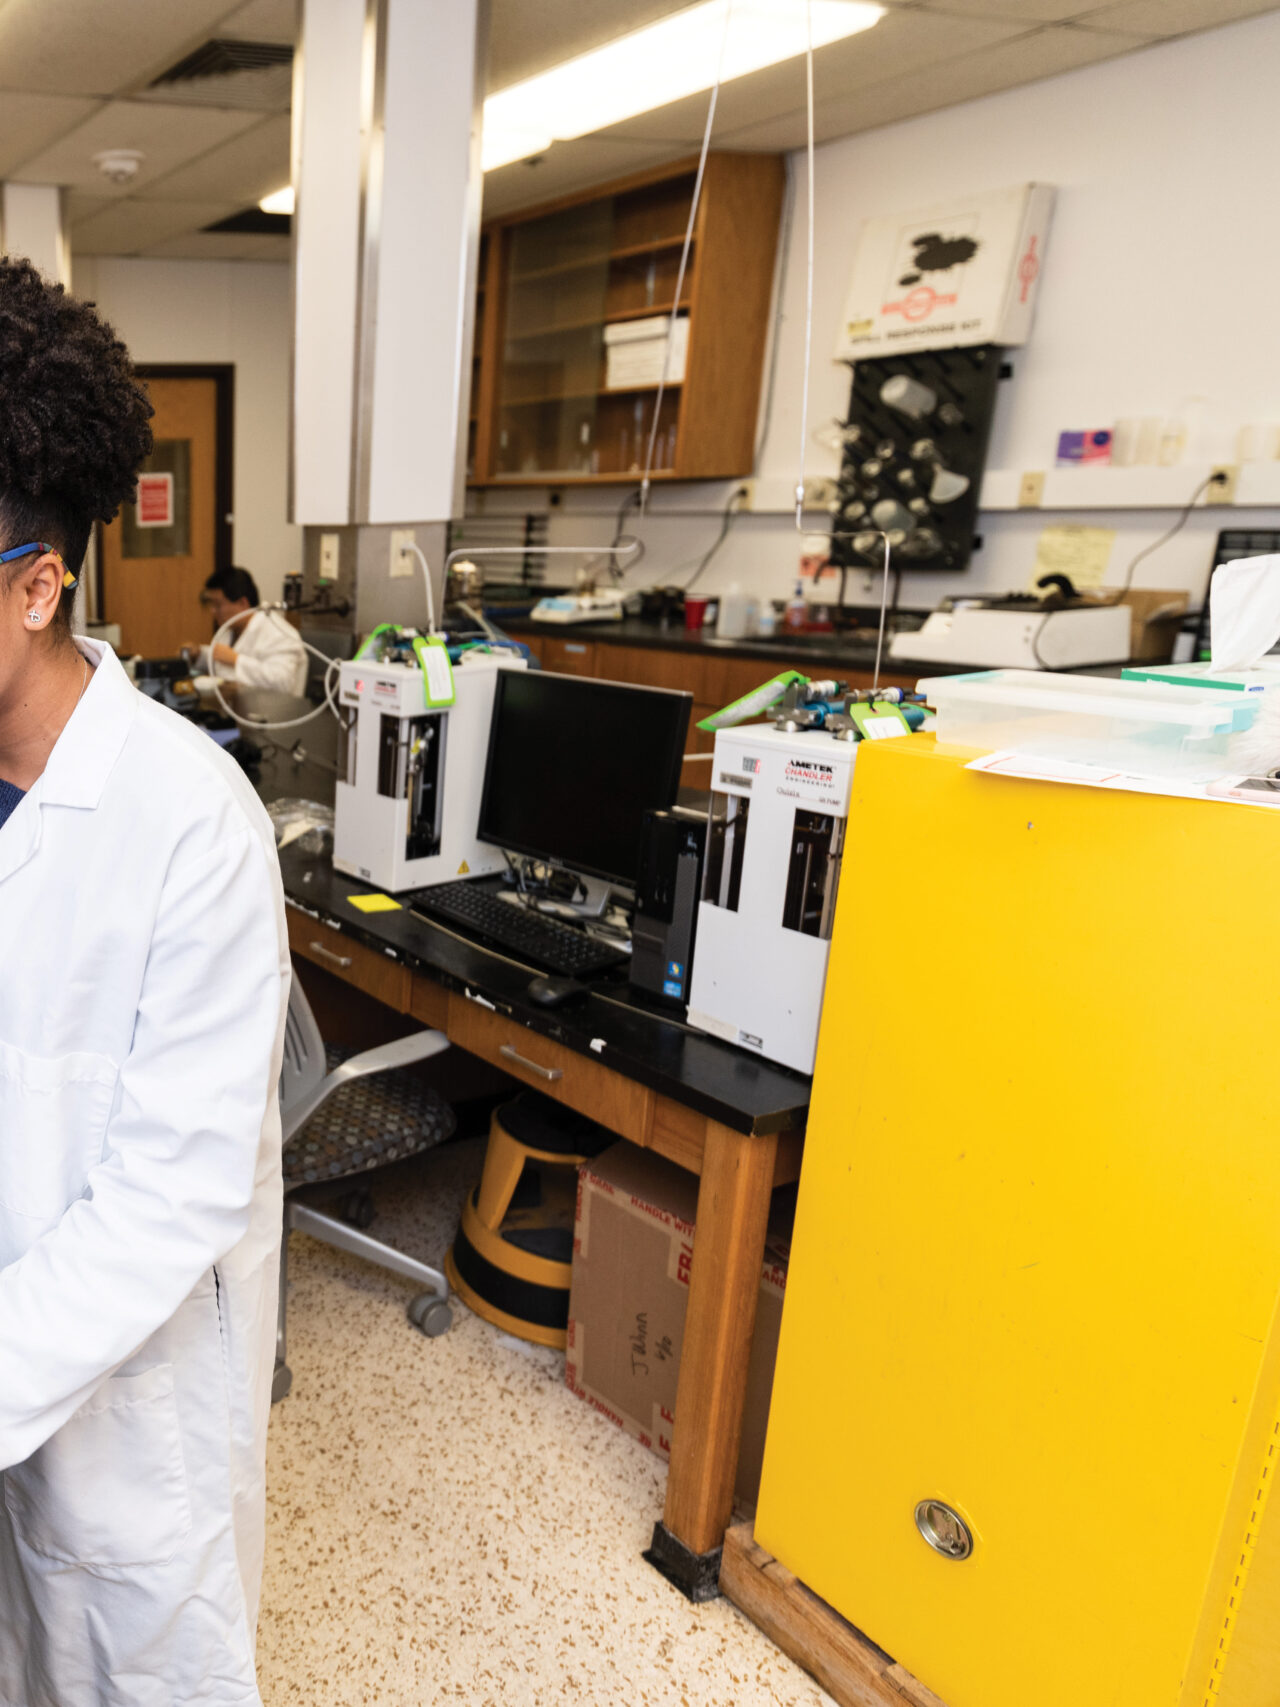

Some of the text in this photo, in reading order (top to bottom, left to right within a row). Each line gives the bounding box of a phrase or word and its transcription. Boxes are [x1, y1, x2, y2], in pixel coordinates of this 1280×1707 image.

[887, 322, 956, 341] RESPONSE
[961, 318, 982, 331] KIT
[785, 767, 833, 782] CHANDLER
[788, 759, 833, 774] AMETEK
[631, 1196, 671, 1225] HANDLE
